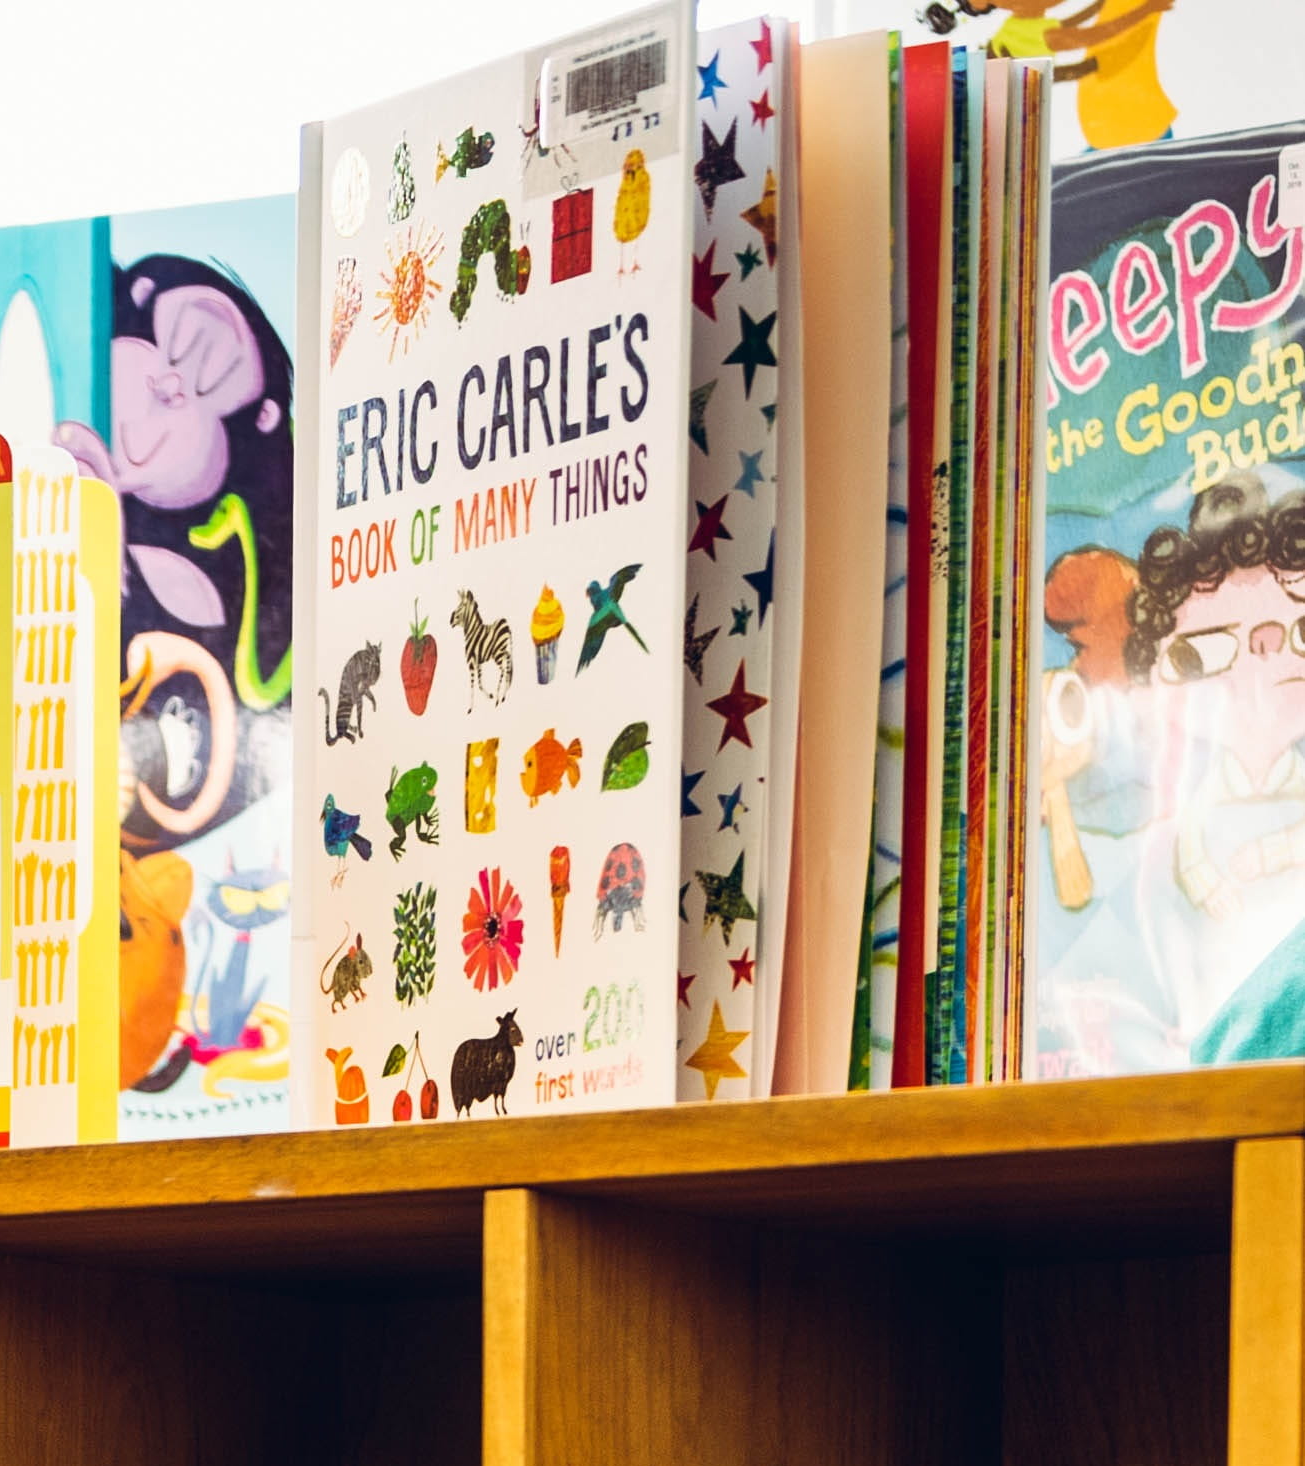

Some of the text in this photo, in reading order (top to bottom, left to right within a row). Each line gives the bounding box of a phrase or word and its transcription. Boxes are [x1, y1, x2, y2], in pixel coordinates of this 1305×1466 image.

[1046, 175, 1305, 409] eepy
[337, 313, 649, 510] ERIC CARLE'S
[1046, 418, 1103, 473] the
[1187, 392, 1305, 493] Bud
[332, 444, 648, 589] BOOK OF MANY THINGS
[535, 1031, 575, 1061] over
[535, 1069, 574, 1104] first
